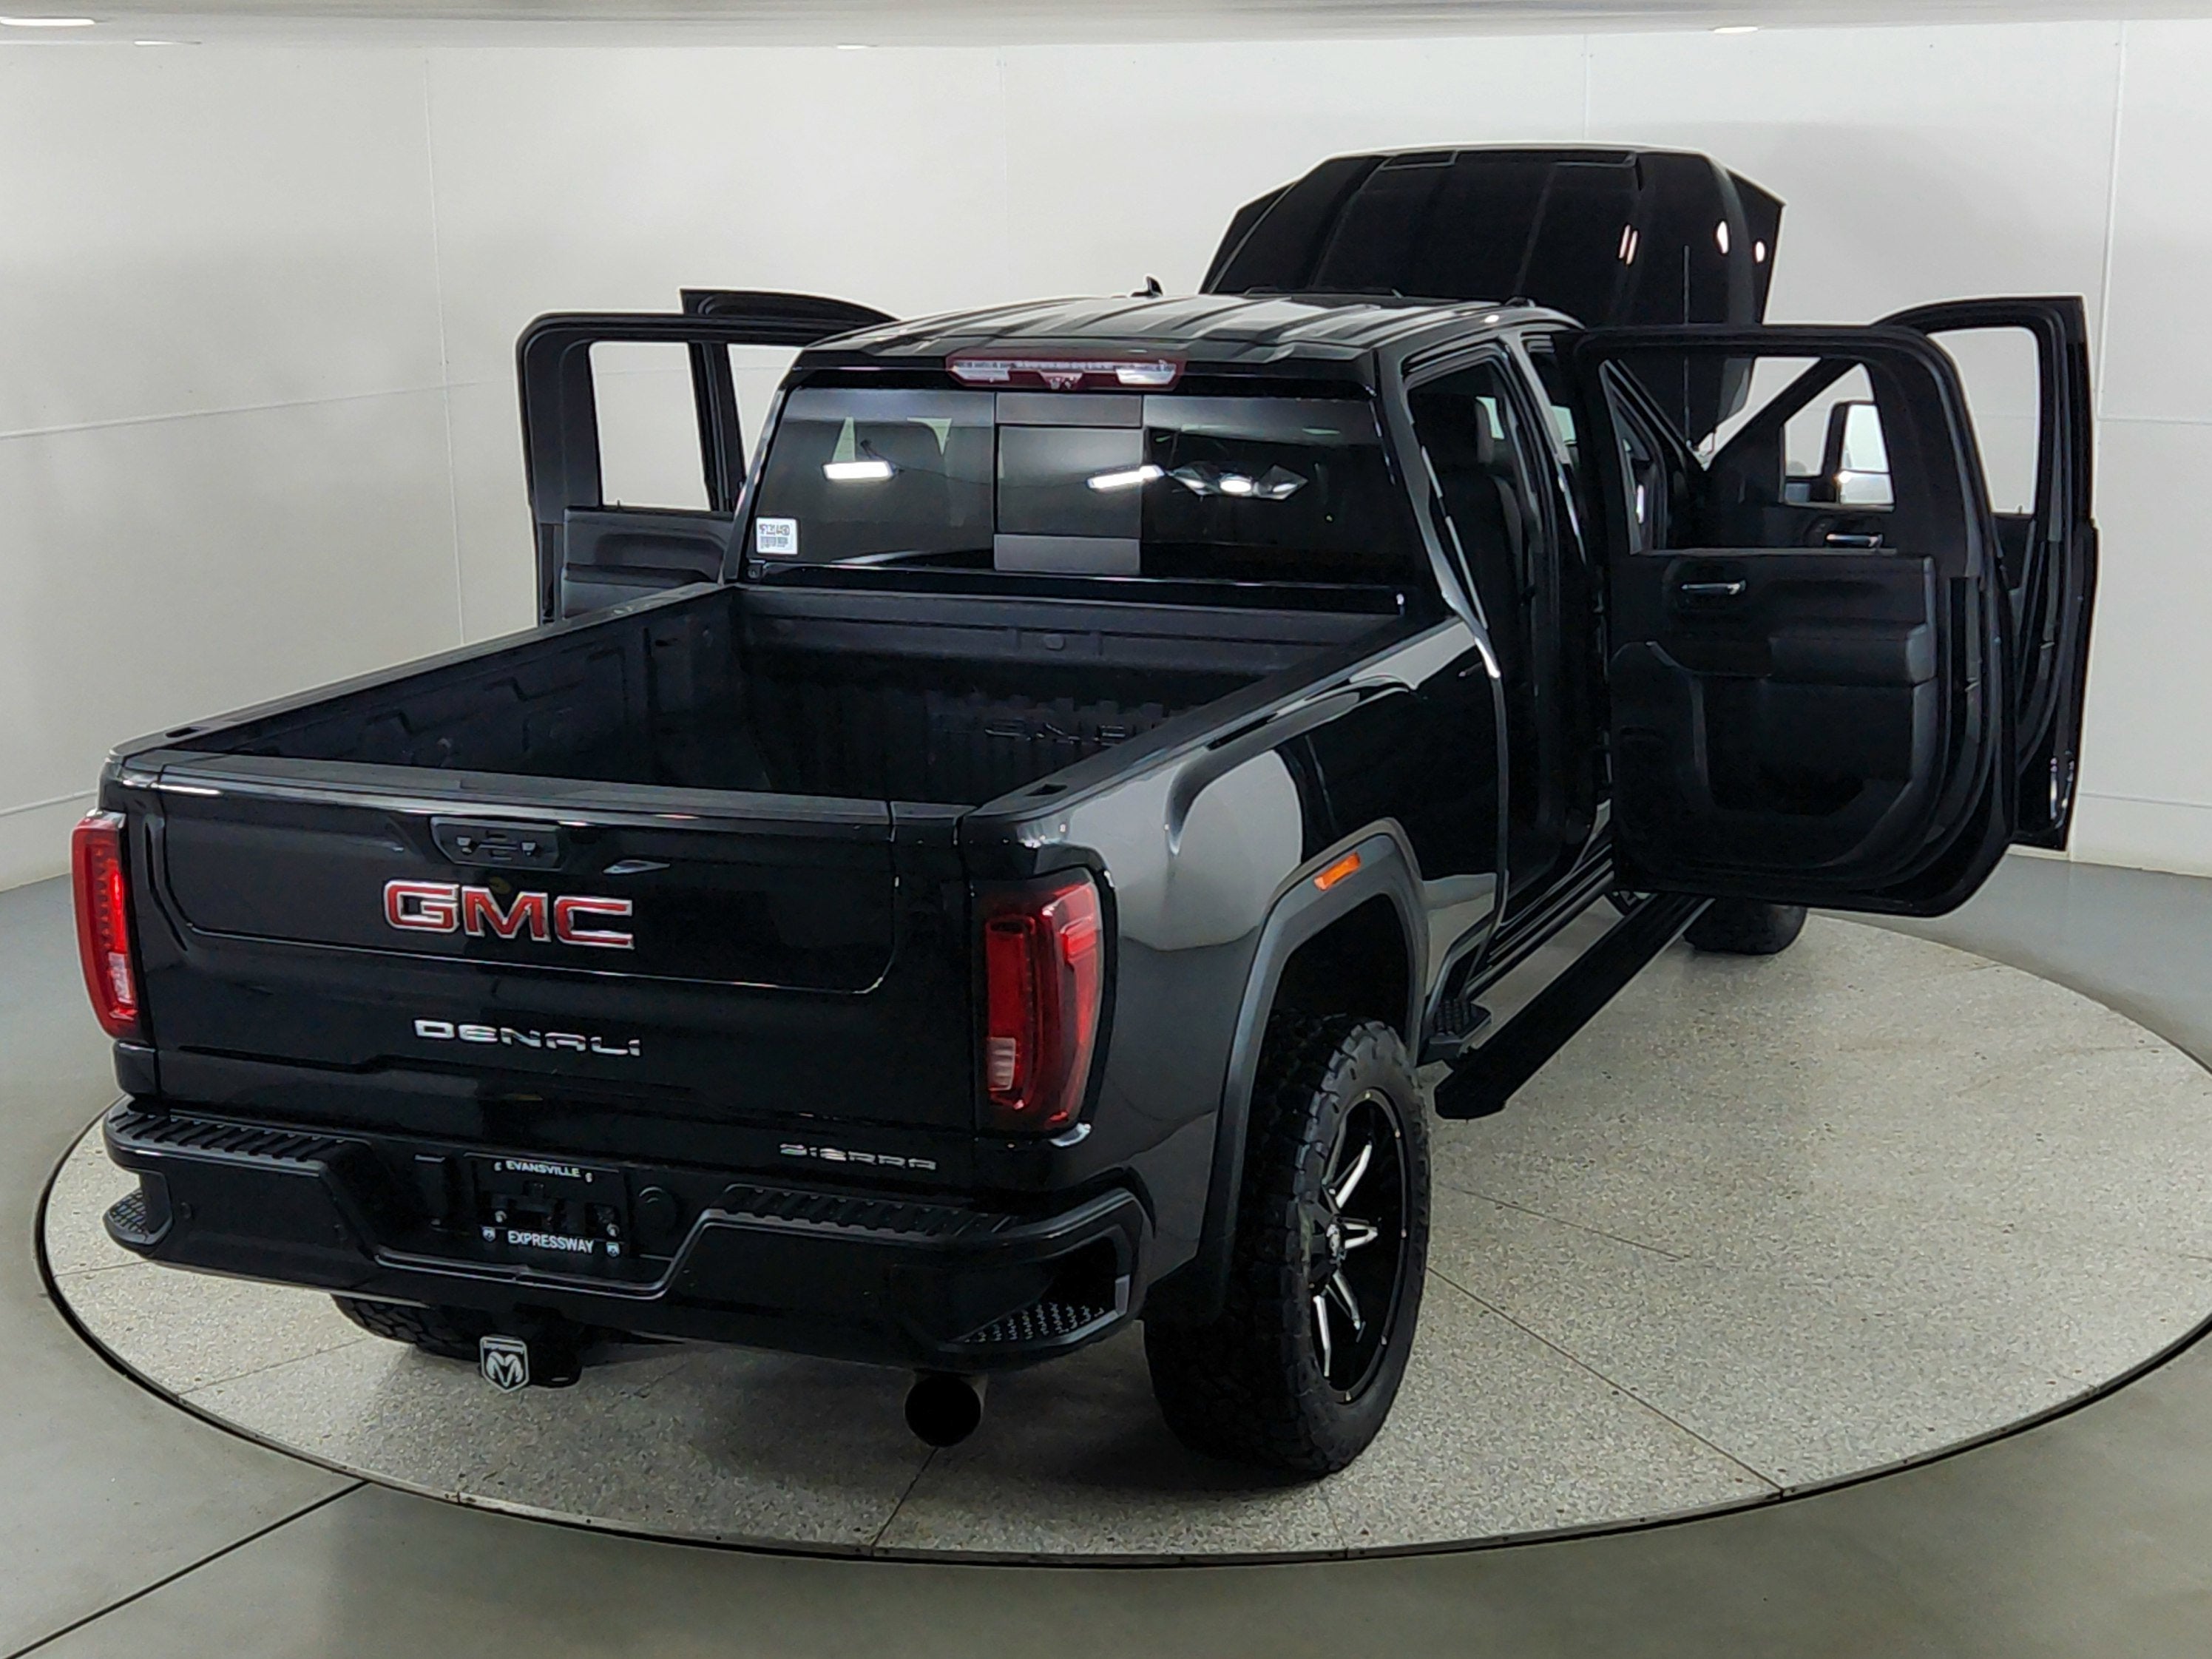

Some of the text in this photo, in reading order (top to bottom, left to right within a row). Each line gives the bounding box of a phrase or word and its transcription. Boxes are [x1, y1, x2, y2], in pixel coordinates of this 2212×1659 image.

[384, 879, 635, 950] GMC
[415, 1019, 640, 1056] DENALI
[506, 1160, 581, 1177] EVANSVILLE
[780, 1143, 936, 1170] SIERRA
[507, 1230, 594, 1253] EXPRESSWAY
